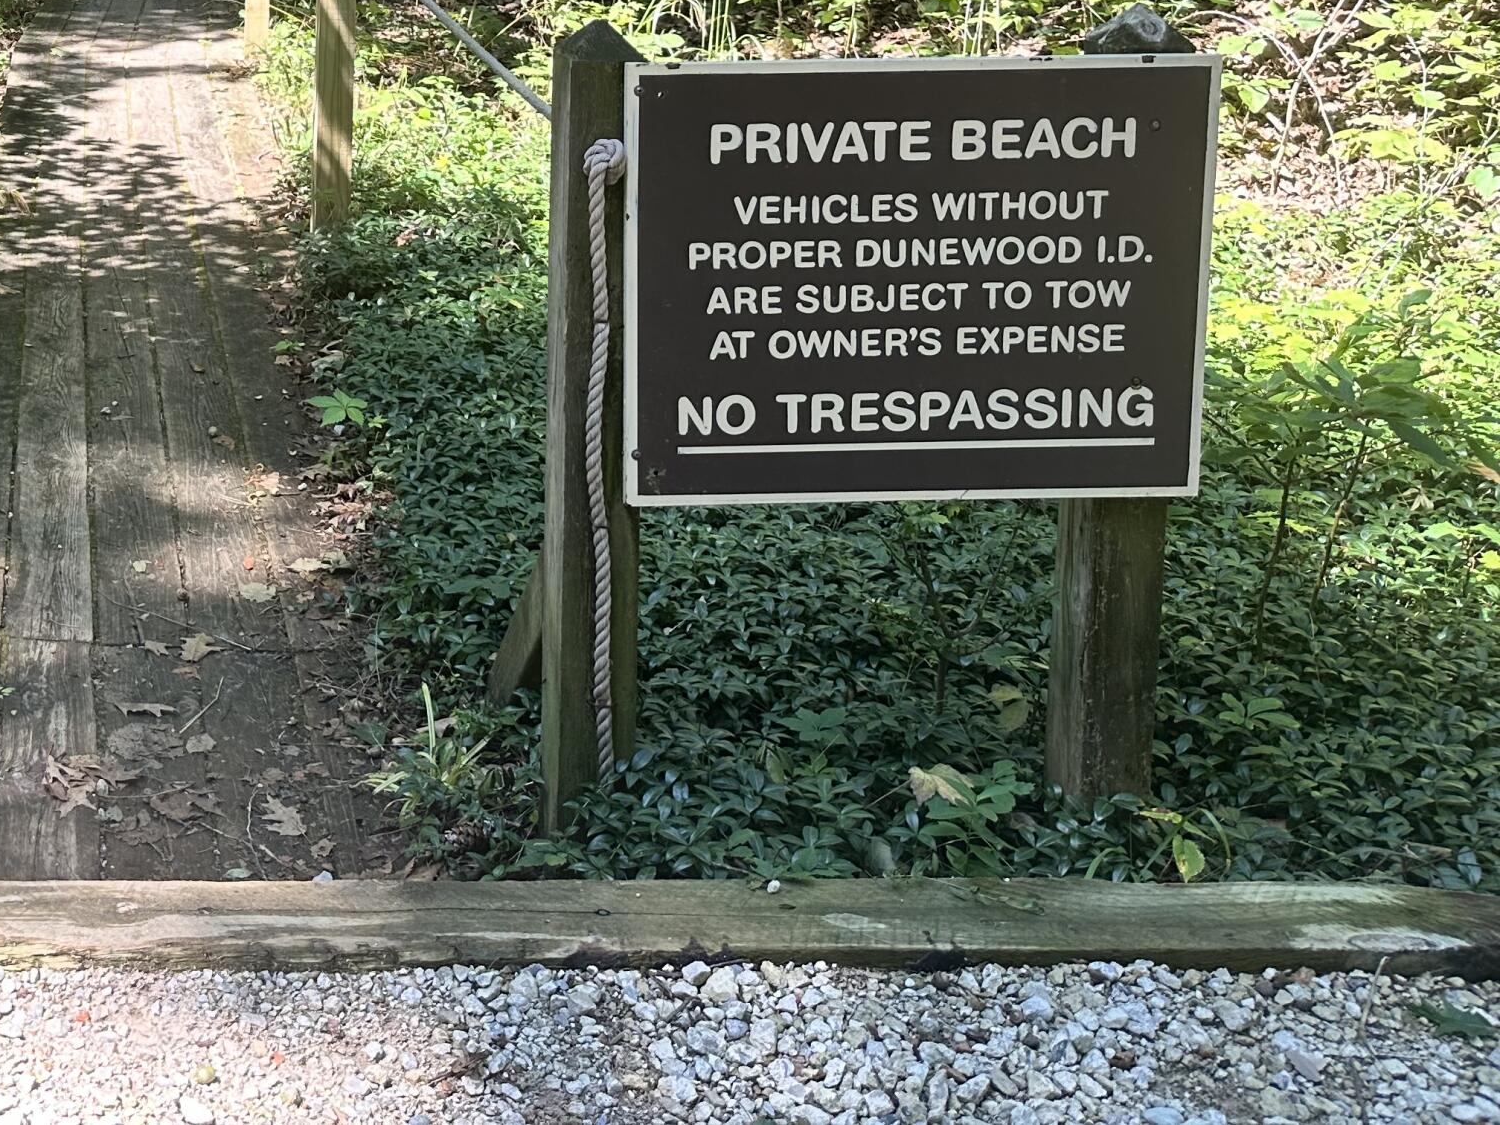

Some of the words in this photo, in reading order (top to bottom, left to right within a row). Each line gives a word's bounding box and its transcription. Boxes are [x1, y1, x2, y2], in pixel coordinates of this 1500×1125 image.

[709, 120, 932, 165] PRIVATE
[950, 117, 1137, 161] BEACH
[733, 193, 918, 225] VEHICLES
[931, 190, 1110, 222] WITHOUT
[688, 239, 841, 270] PROPER
[855, 235, 1082, 268] DUNEWOOD
[1097, 235, 1153, 263] I.D.
[706, 285, 782, 316] ARE
[796, 282, 969, 314] SUBJECT
[981, 281, 1032, 310] TO
[1045, 280, 1131, 308] TOW
[709, 330, 755, 361] AT
[768, 327, 942, 359] OWNER'S
[956, 324, 1125, 355] EXPENSE
[677, 395, 756, 436] NO
[776, 385, 1155, 434] TRESPASSING
